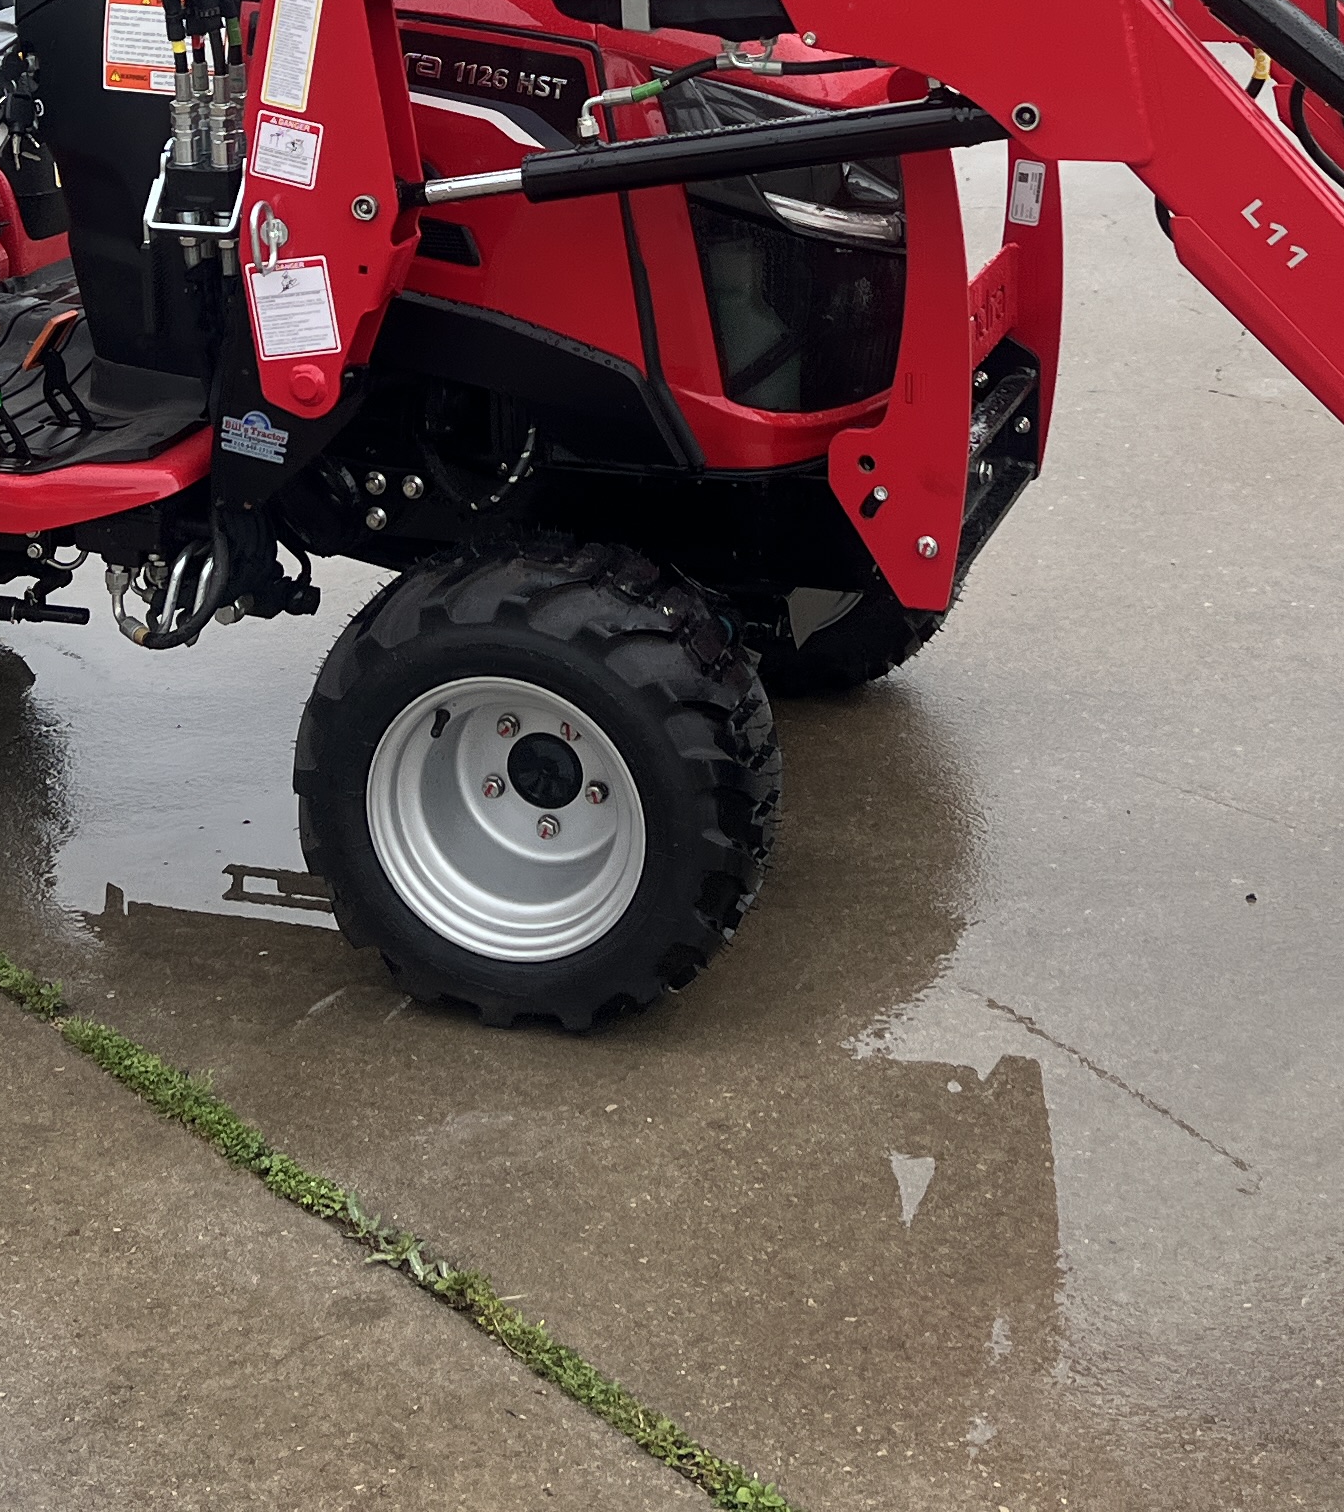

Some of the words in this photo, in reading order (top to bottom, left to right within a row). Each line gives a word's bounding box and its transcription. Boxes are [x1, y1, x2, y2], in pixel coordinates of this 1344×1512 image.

[454, 61, 509, 90] 1126
[517, 71, 568, 99] HST
[278, 117, 311, 133] DANGER
[1241, 198, 1309, 269] L11
[276, 261, 305, 271] DANGER
[225, 420, 249, 433] Bill's
[251, 426, 286, 442] Tractor
